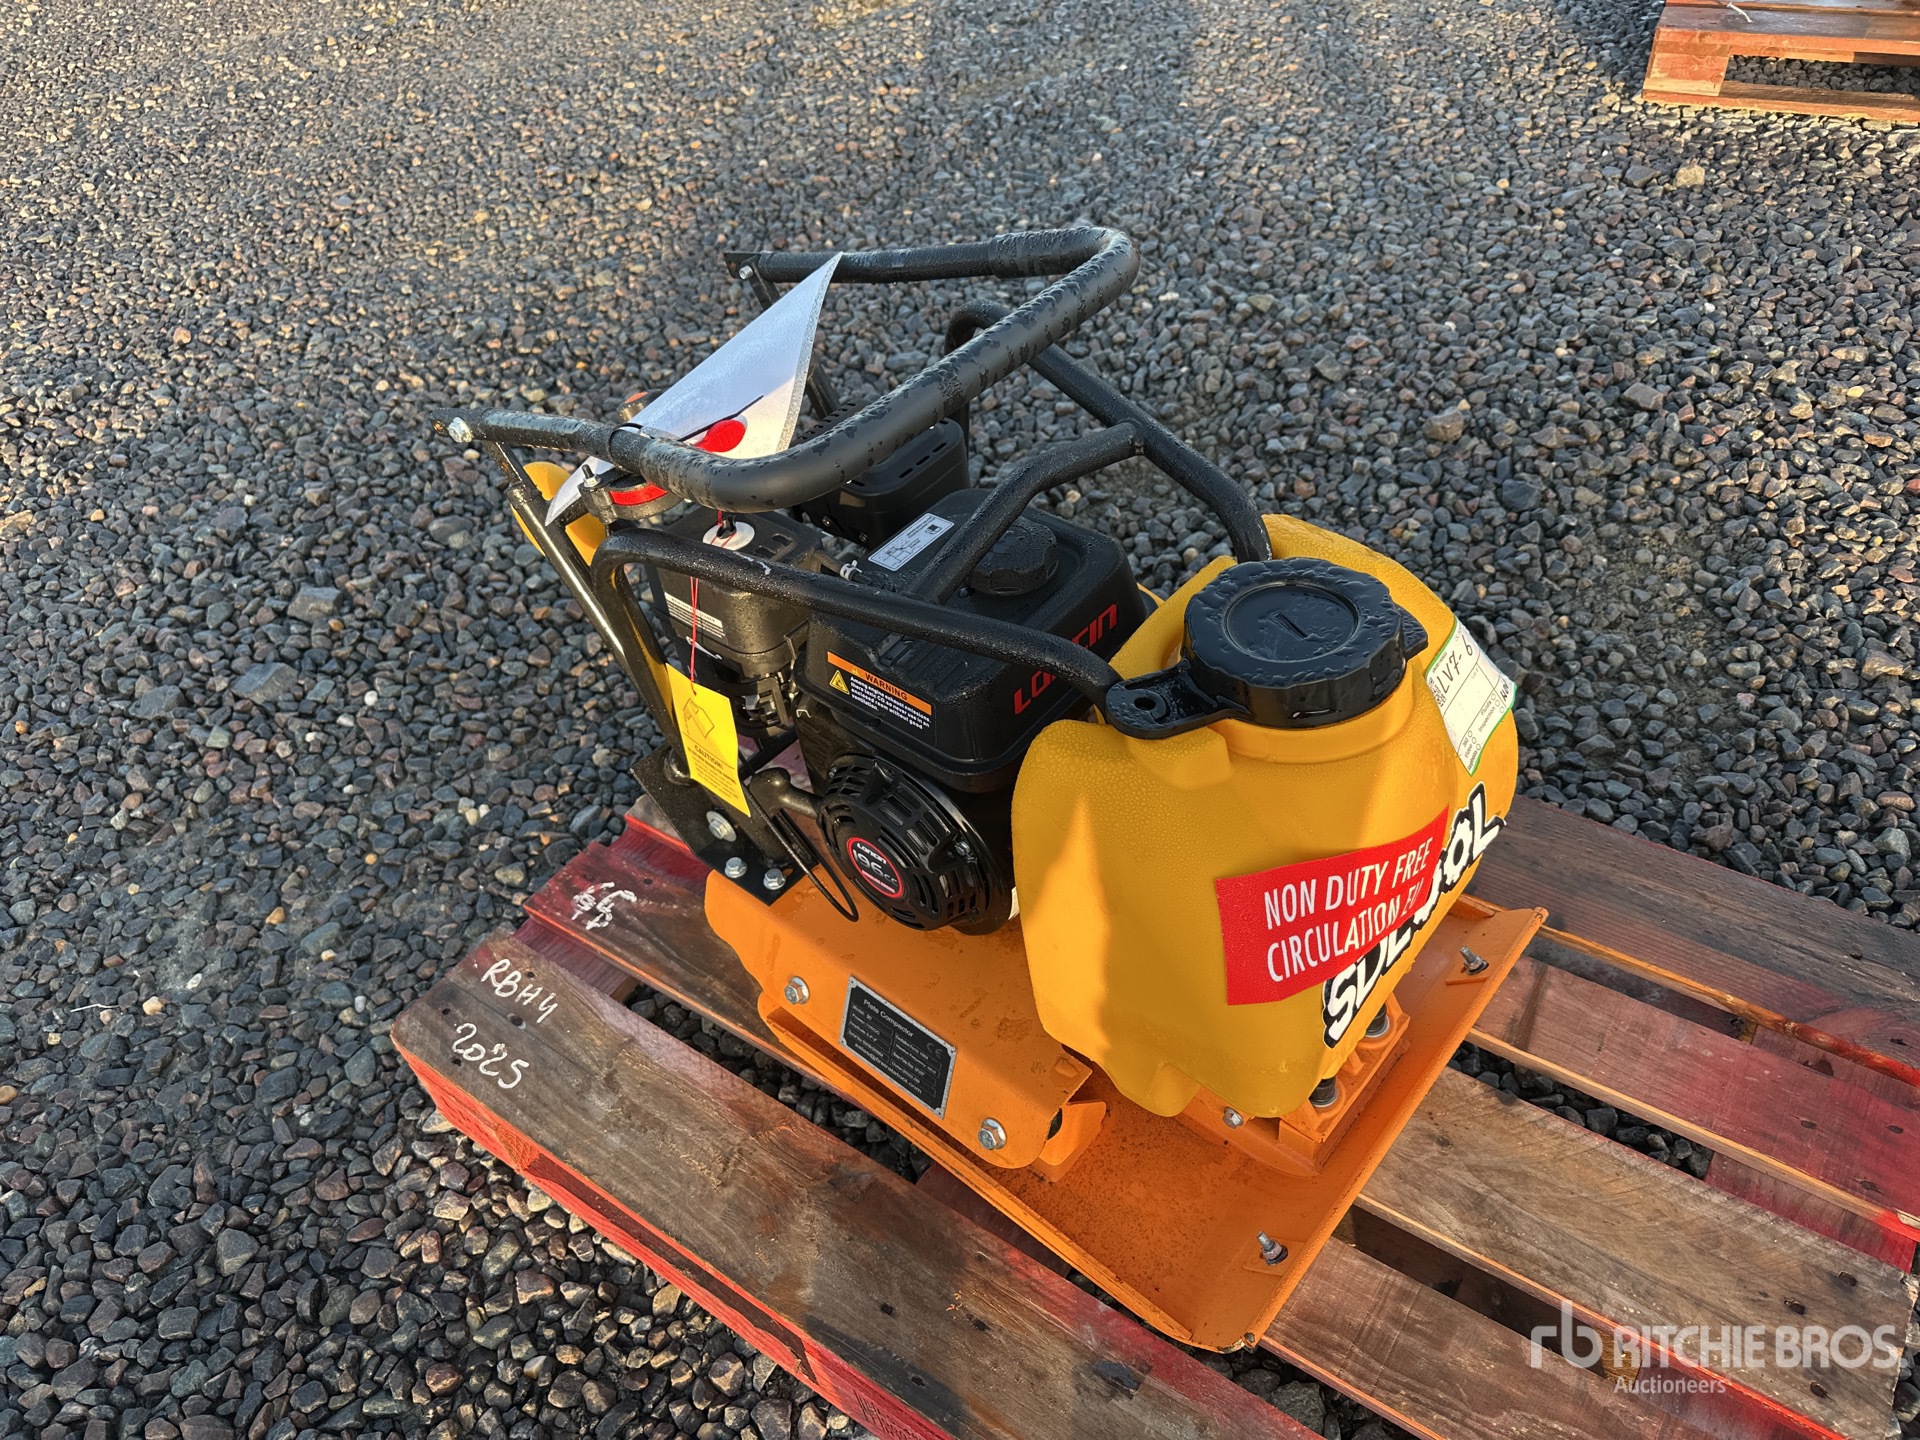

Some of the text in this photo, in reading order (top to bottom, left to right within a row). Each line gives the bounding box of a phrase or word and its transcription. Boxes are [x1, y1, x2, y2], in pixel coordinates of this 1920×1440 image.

[1014, 603, 1118, 715] LOCIN
[865, 672, 908, 700] WARNING
[890, 708, 908, 722] without
[1478, 706, 1496, 732] Inspection
[1264, 837, 1433, 930] NON DUTY FREE
[1267, 878, 1424, 982] CIRCULATION EU
[864, 998, 879, 1014] Plate
[880, 1010, 914, 1038] Compactor
[452, 1022, 530, 1089] 2025
